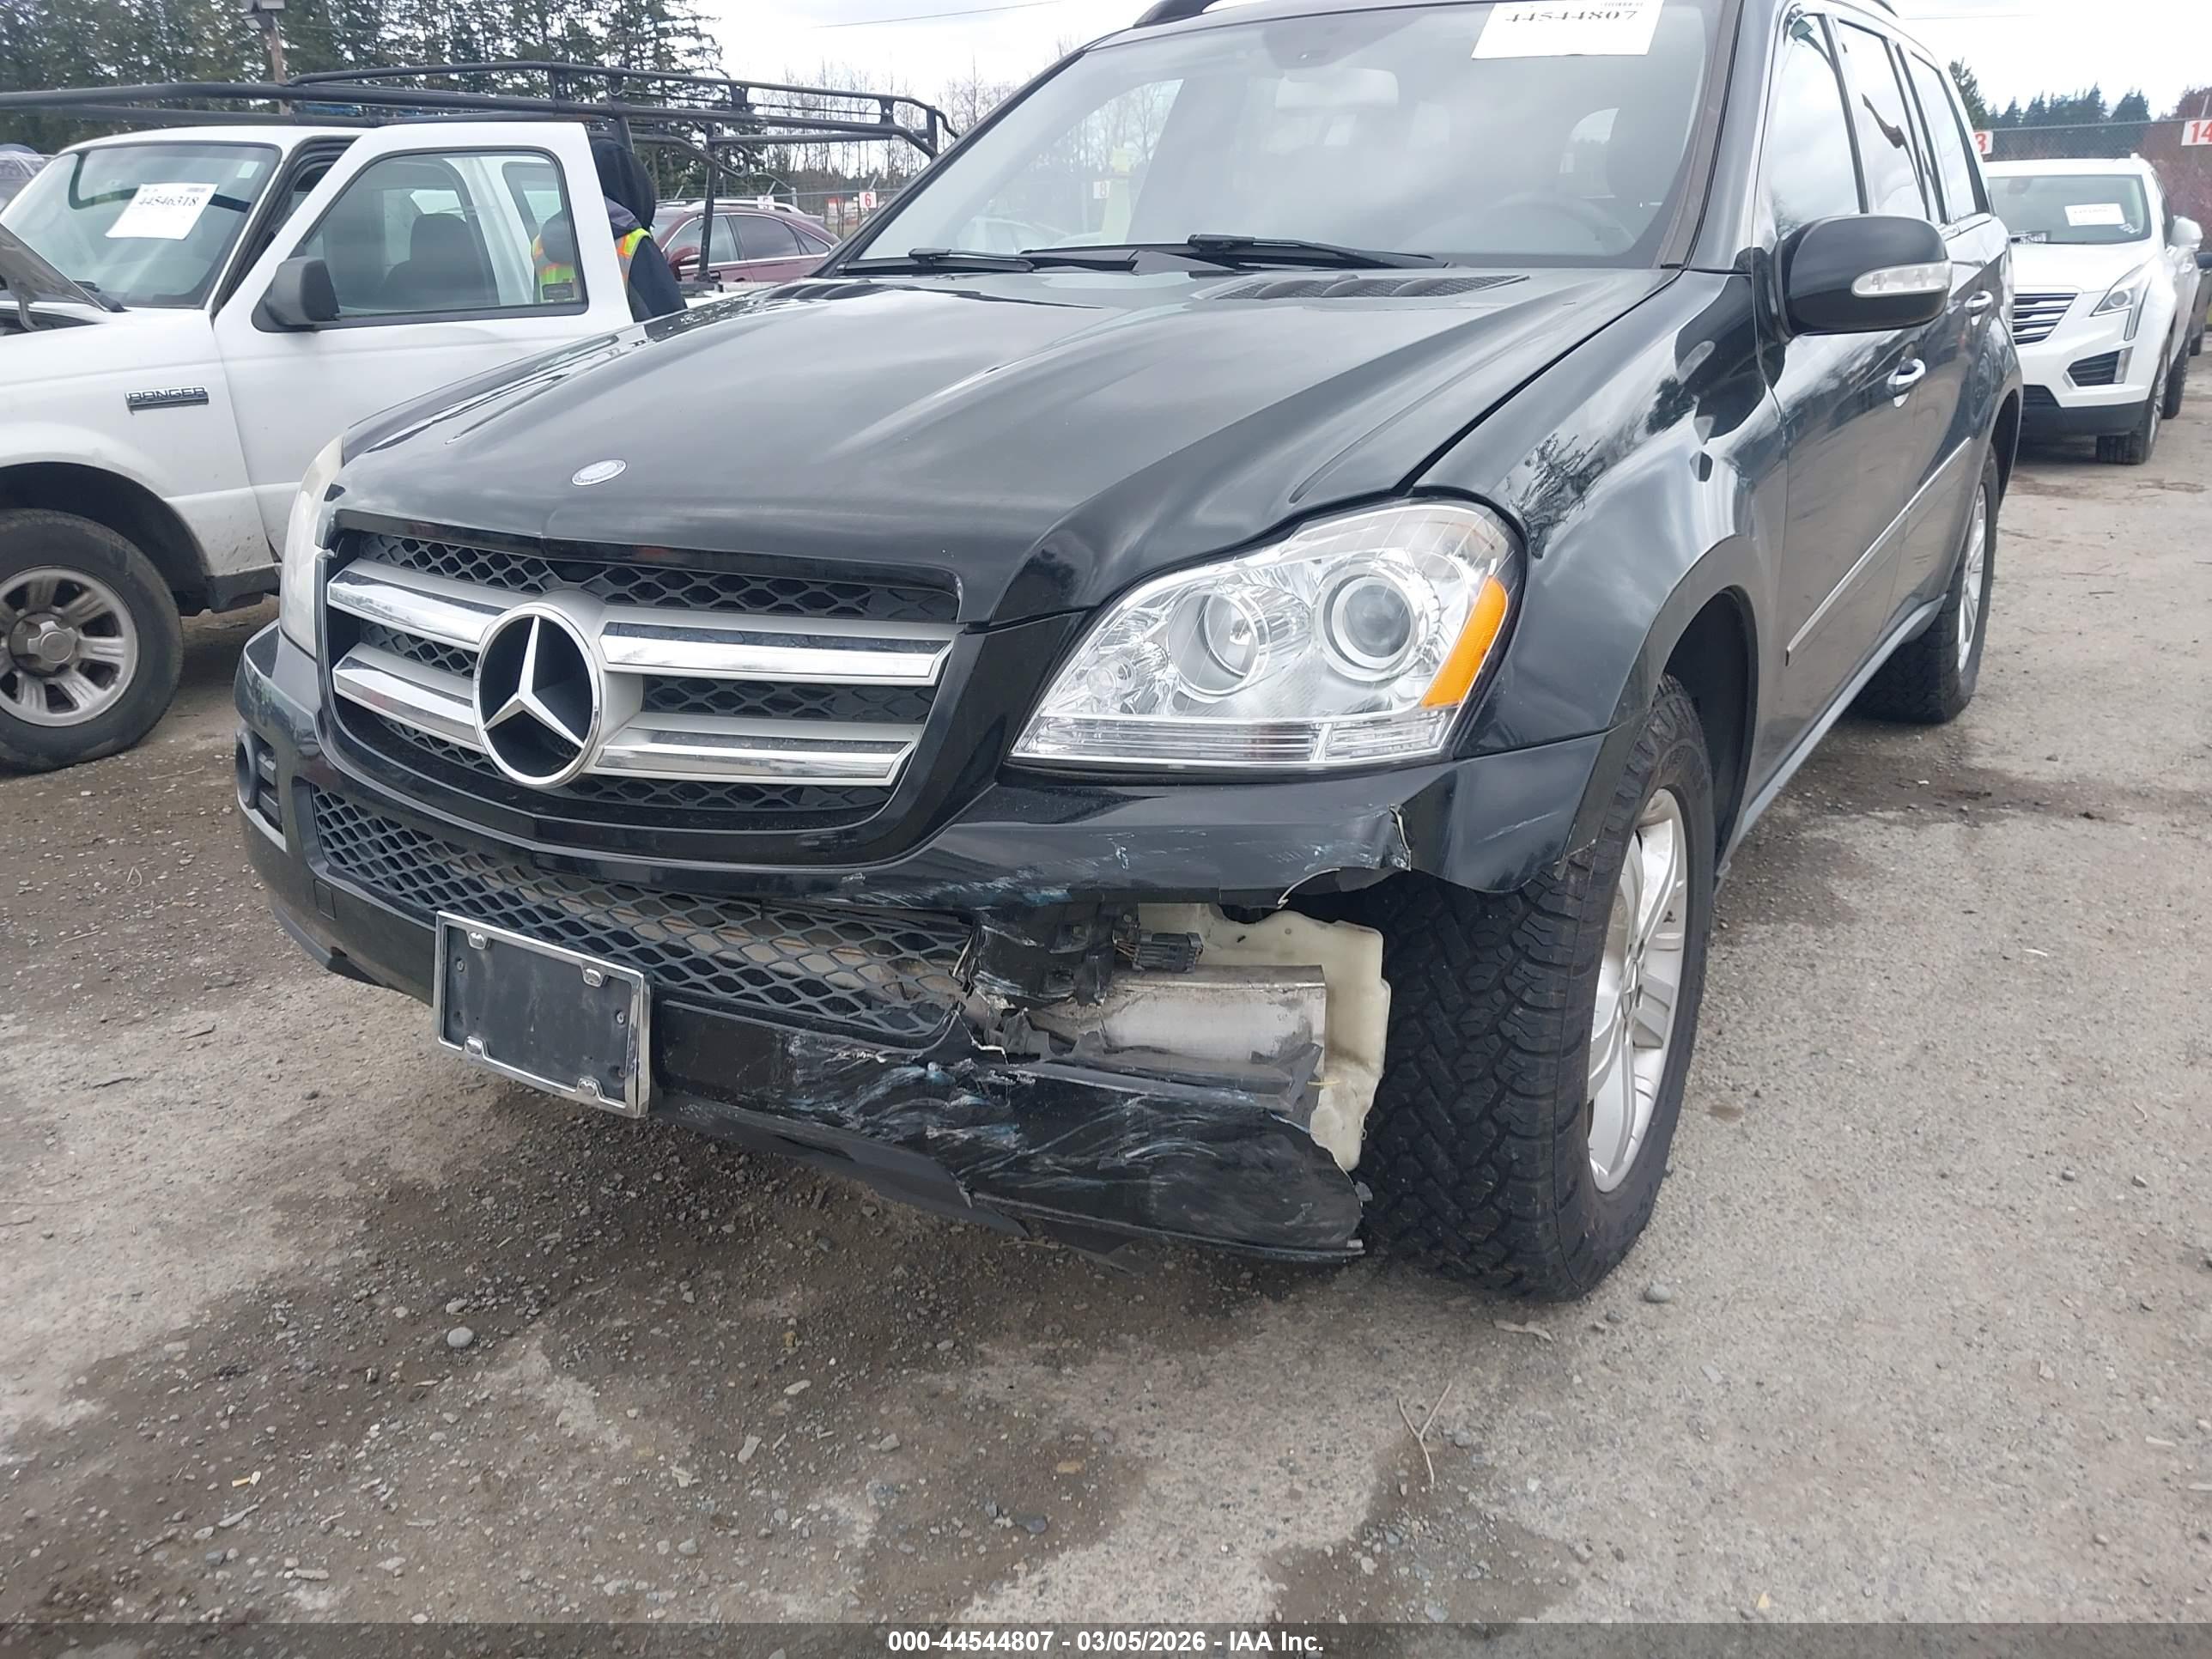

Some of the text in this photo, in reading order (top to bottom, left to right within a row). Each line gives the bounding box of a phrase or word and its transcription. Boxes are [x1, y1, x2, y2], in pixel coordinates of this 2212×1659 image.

[1505, 10, 1638, 22] 44544807
[2191, 122, 2212, 143] 14
[865, 193, 872, 207] 6
[127, 386, 206, 401] RANGER
